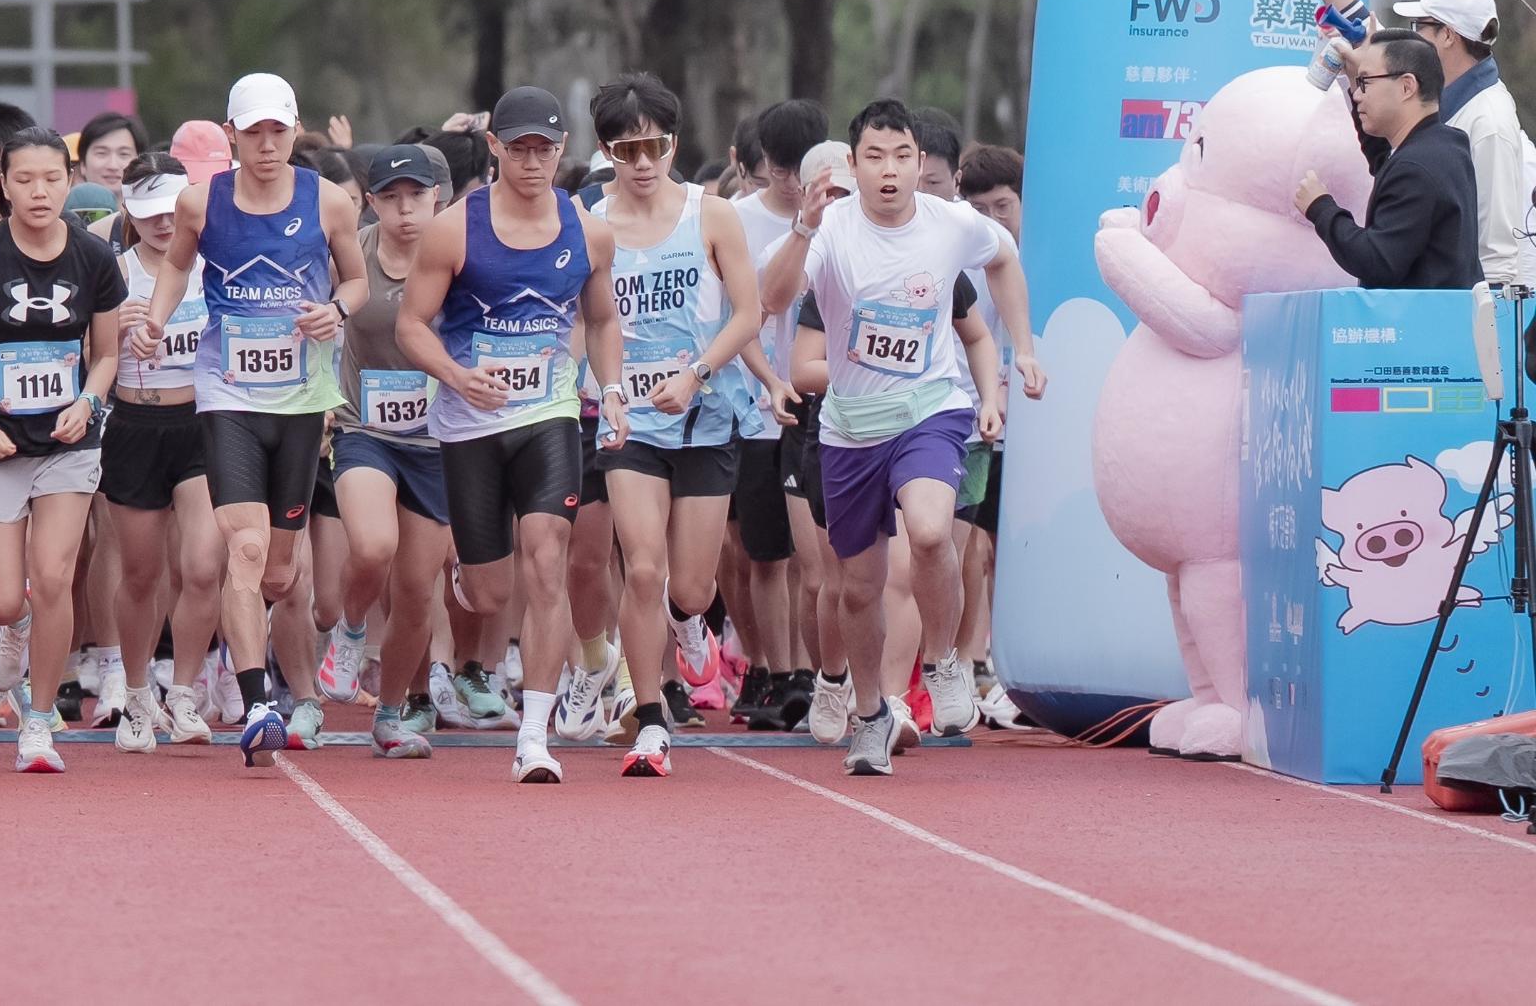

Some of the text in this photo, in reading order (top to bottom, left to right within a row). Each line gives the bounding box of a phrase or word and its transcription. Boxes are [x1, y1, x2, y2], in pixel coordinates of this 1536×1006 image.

[1128, 24, 1190, 37] insurance
[1254, 34, 1316, 48] TSUI WAH
[1123, 101, 1202, 139] am73
[661, 250, 694, 260] GARMIN
[225, 286, 302, 300] TEAM ASICS
[614, 267, 699, 297] OM ZERO
[637, 289, 685, 314] HERO
[482, 316, 559, 333] TEAM ASICS
[162, 329, 205, 357] 146
[866, 334, 920, 363] 1342
[236, 347, 293, 373] 1355
[16, 372, 63, 399] 1114
[376, 397, 428, 424] 1332
